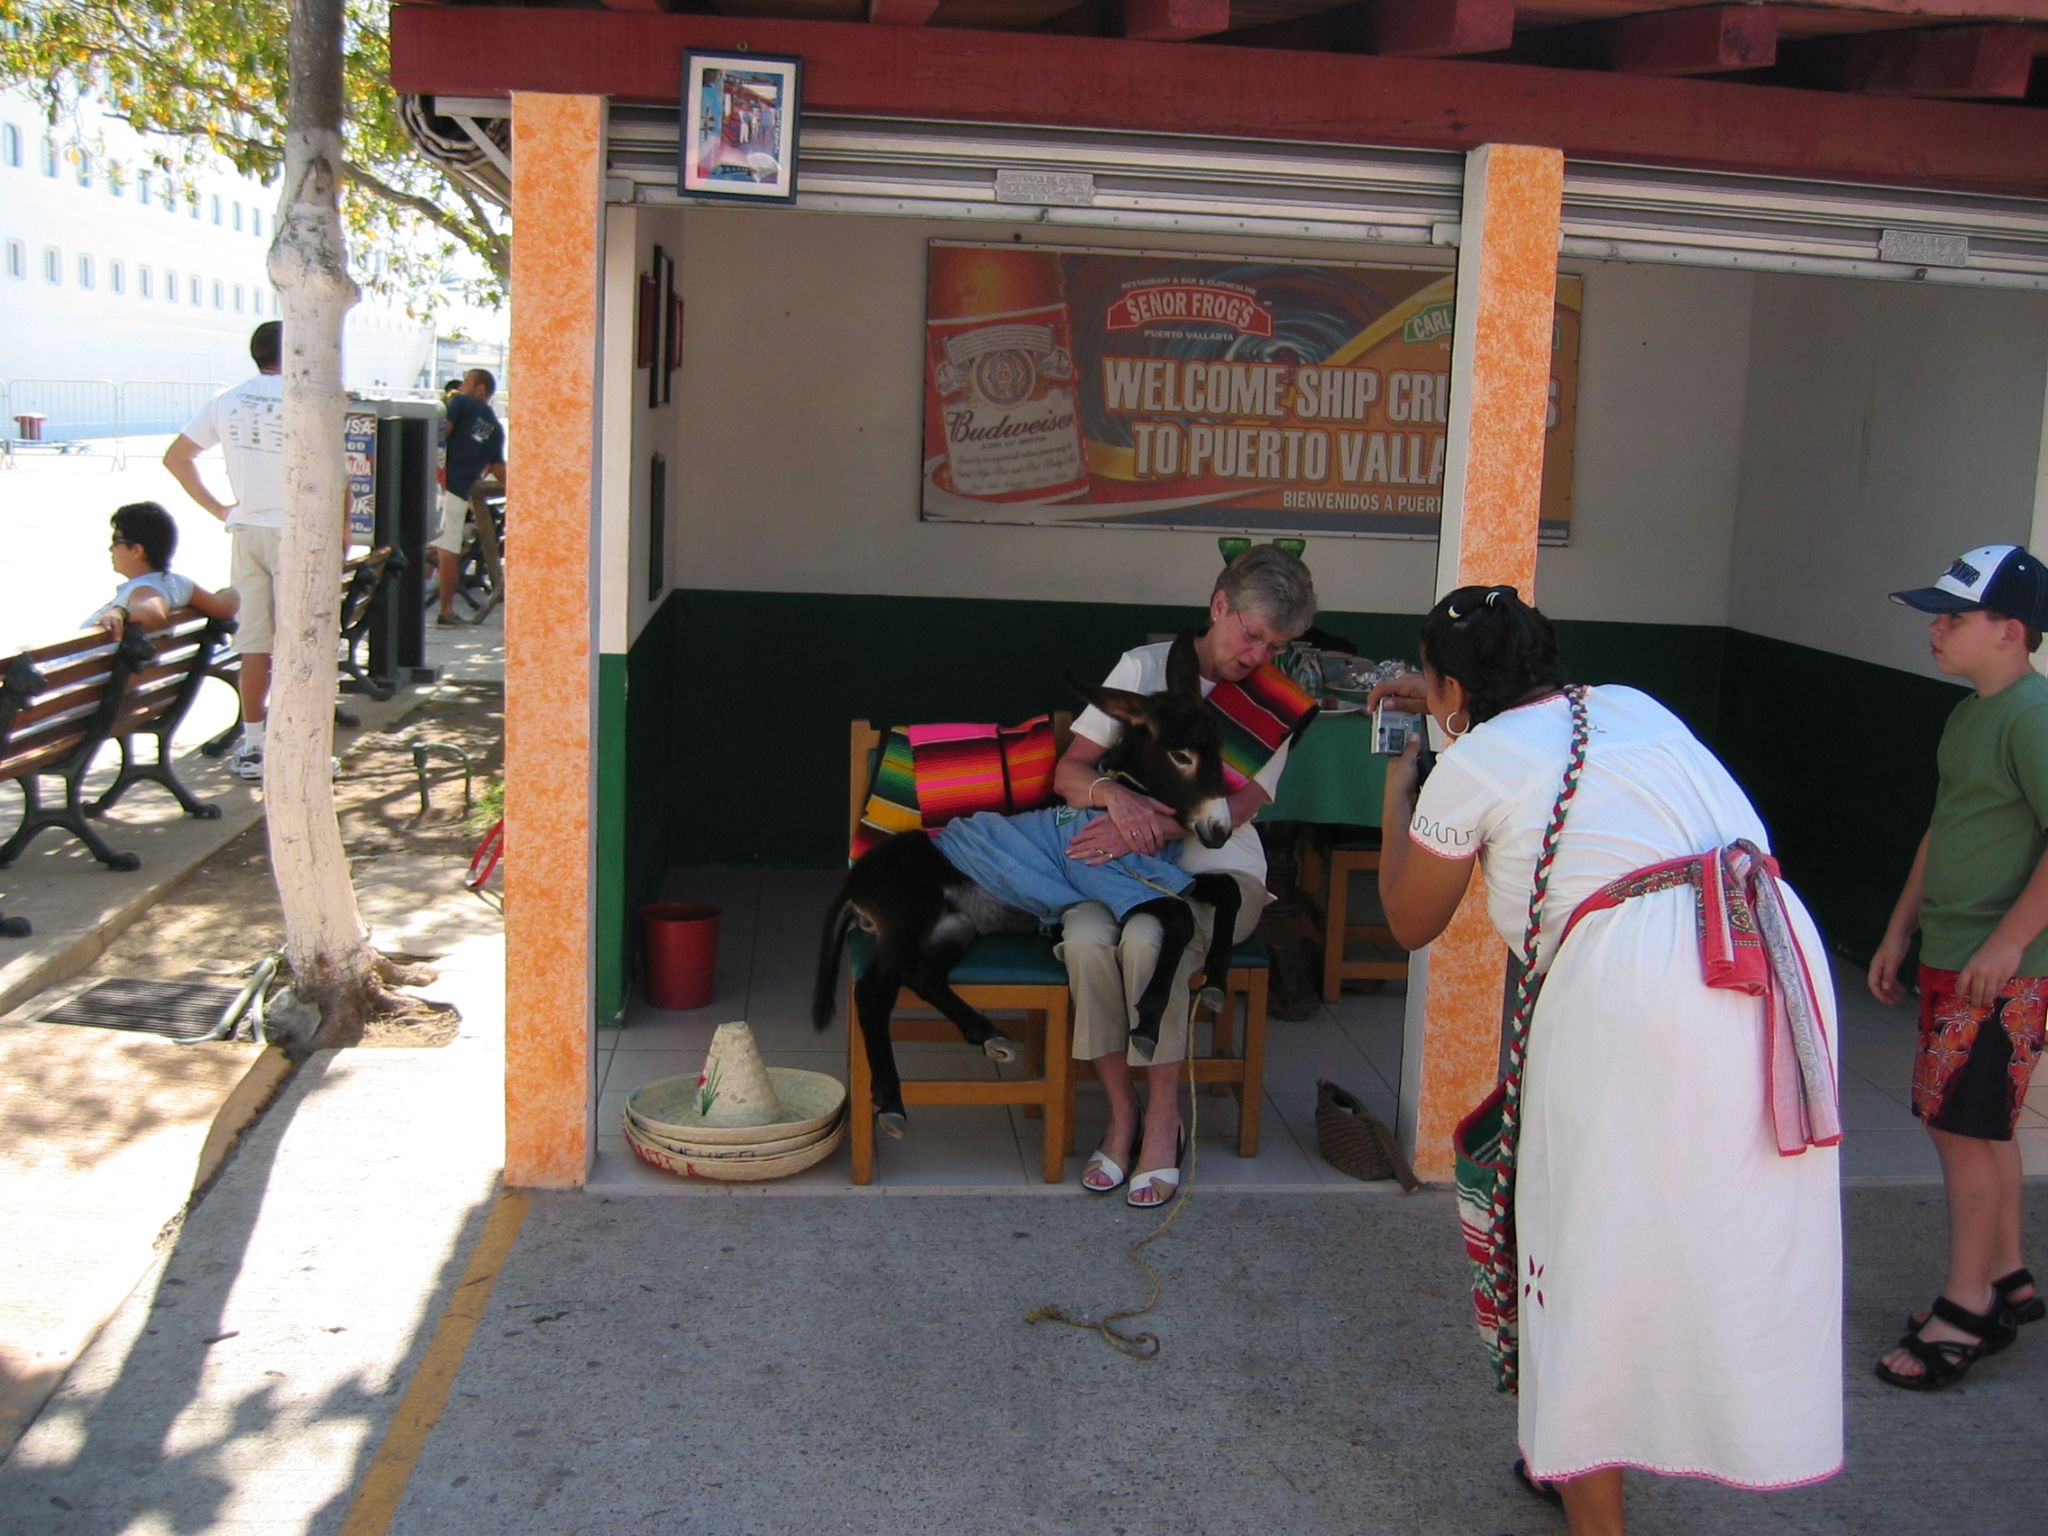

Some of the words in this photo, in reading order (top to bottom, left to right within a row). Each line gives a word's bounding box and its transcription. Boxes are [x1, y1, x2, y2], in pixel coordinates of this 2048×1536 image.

[1192, 292, 1254, 328] FROG'S
[1144, 329, 1183, 339] PUERTO
[1186, 330, 1234, 342] VALLARTA
[1105, 359, 1285, 416] WELCOME
[1297, 368, 1378, 420] SHIP
[946, 408, 1074, 443] Budweiser
[1135, 424, 1177, 474] TO
[1190, 426, 1327, 481] PUERTO
[1340, 431, 1444, 485] VALLA
[1283, 490, 1380, 511] BIENVENIDOS
[1384, 494, 1393, 512] A
